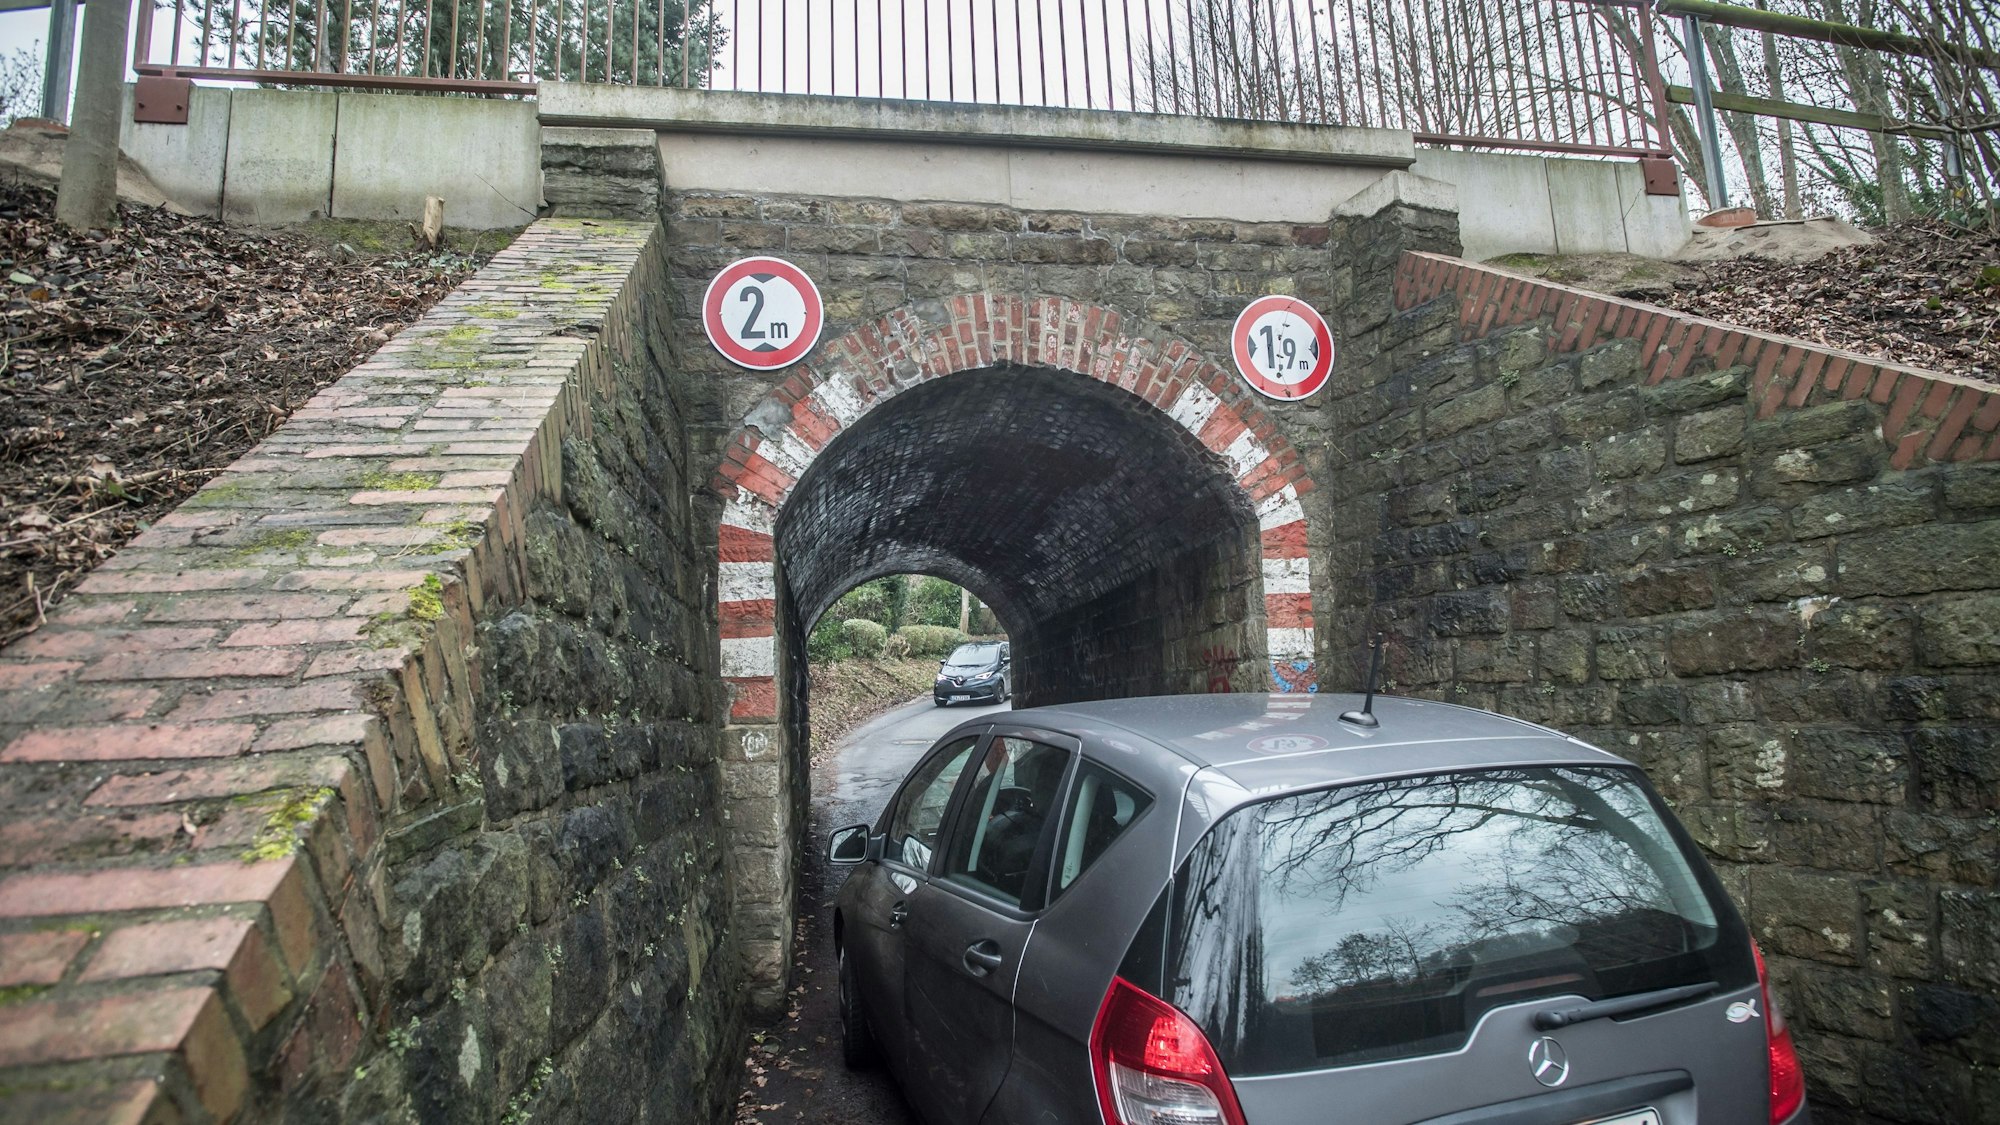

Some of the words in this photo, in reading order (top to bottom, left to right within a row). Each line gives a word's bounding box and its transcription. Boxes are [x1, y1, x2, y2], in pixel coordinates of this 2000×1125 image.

[740, 286, 765, 339] 2
[770, 321, 788, 339] m
[1299, 360, 1309, 370] m
